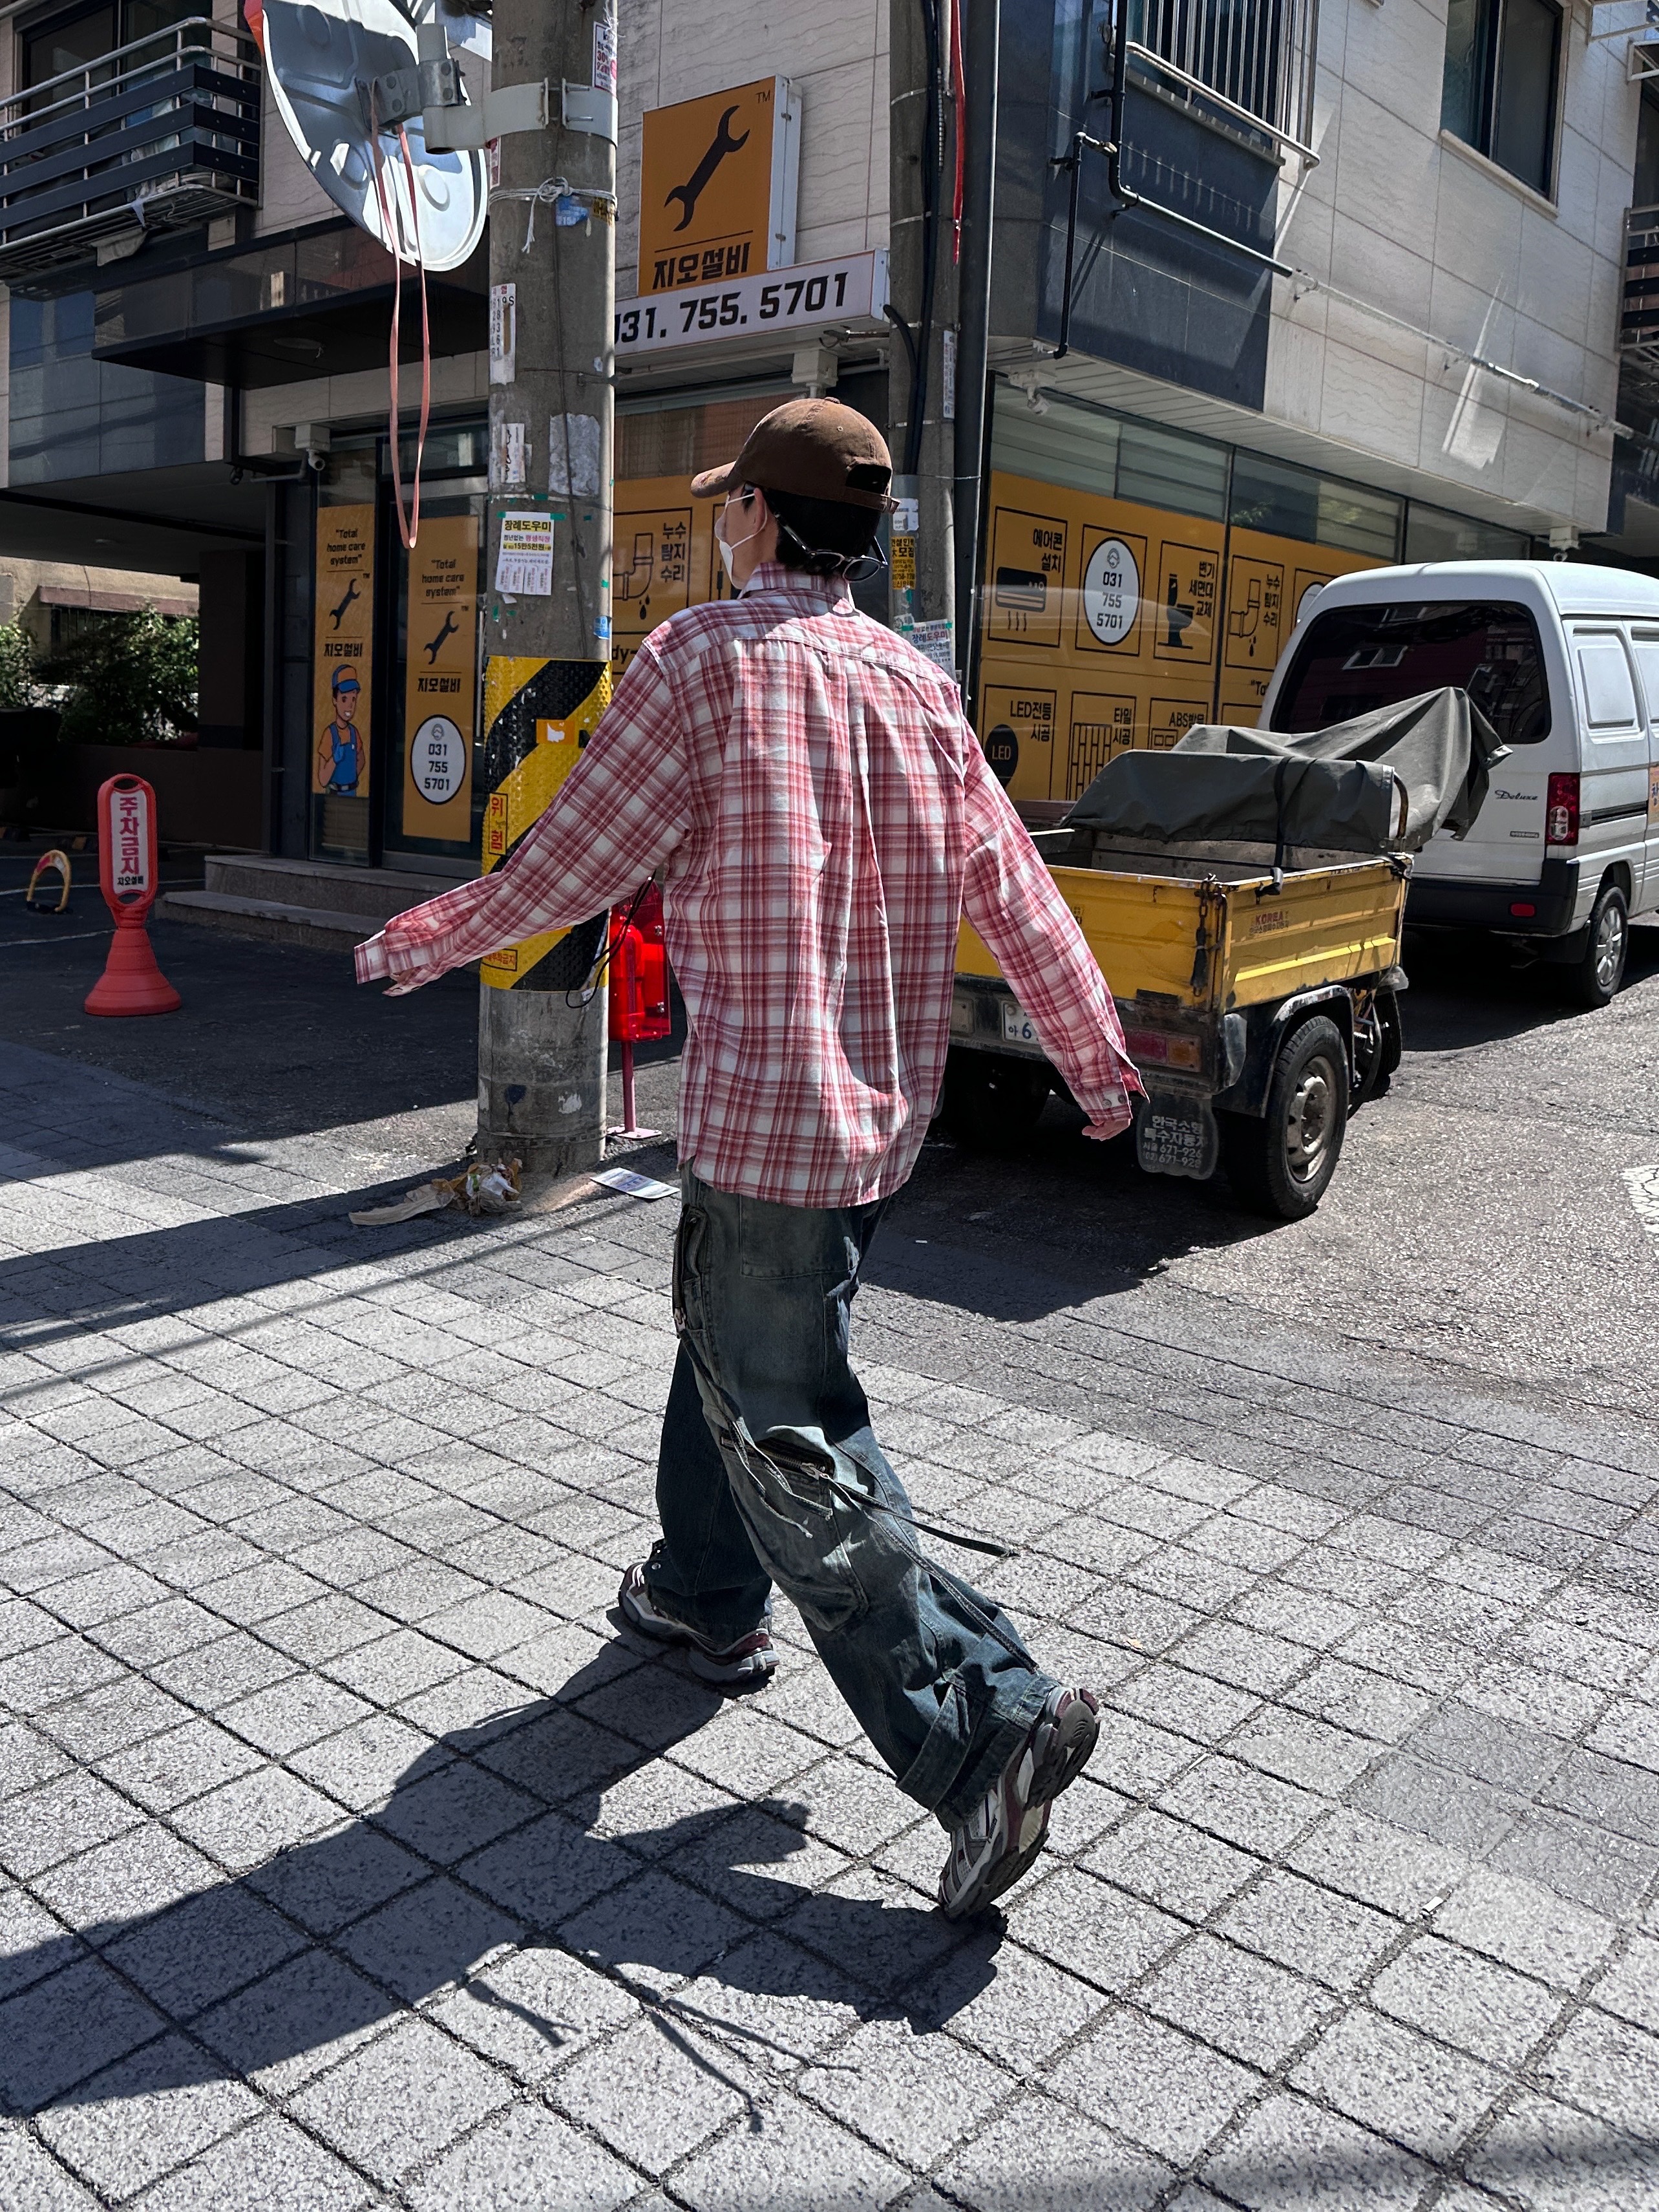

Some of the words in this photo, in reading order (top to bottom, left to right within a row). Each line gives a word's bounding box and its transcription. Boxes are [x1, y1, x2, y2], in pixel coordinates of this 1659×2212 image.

[755, 89, 770, 103] TM
[652, 242, 750, 289] 지오설비
[680, 292, 747, 333] 755.
[759, 271, 849, 319] 5701
[335, 528, 358, 538] "Total
[504, 520, 551, 533] 장례도우미
[662, 522, 686, 539] 누수
[327, 543, 346, 552] home
[348, 542, 366, 551] care
[525, 535, 551, 543] 평생직장
[1033, 528, 1063, 551] 에어콘
[330, 554, 362, 566] system"
[661, 543, 685, 561] 탐지
[431, 559, 456, 569] "Total
[1041, 553, 1061, 573] 설치
[1199, 561, 1214, 579] 변기
[422, 574, 443, 584] home
[445, 573, 465, 582] care
[660, 564, 685, 582] 수리
[1103, 571, 1123, 588] 031
[1189, 579, 1214, 599] 세면대
[1266, 574, 1280, 590] 누수
[425, 586, 461, 599] system"
[1102, 591, 1121, 609] 755
[1265, 593, 1279, 609] 탐지
[1196, 601, 1212, 618] 교체
[1097, 613, 1123, 629] 5701
[1263, 613, 1278, 628] 수리
[912, 630, 948, 644] 장례도우미
[324, 643, 363, 657] 지오설비
[417, 677, 460, 693] 지오설비
[1251, 679, 1270, 696] "To
[1010, 700, 1052, 721] LED전등
[1114, 707, 1132, 725] 타일
[1030, 728, 1050, 743] 시공
[1112, 727, 1131, 745] 시공
[428, 744, 447, 756] 031
[991, 745, 1011, 760] LED
[428, 761, 448, 773] 755
[424, 778, 450, 791] 5701
[1495, 790, 1537, 800] Deluxe
[120, 797, 140, 875] 주차금지
[1022, 1022, 1035, 1039] 6
[1152, 1115, 1203, 1134] 한국소형
[1159, 1144, 1201, 1158] 671-926
